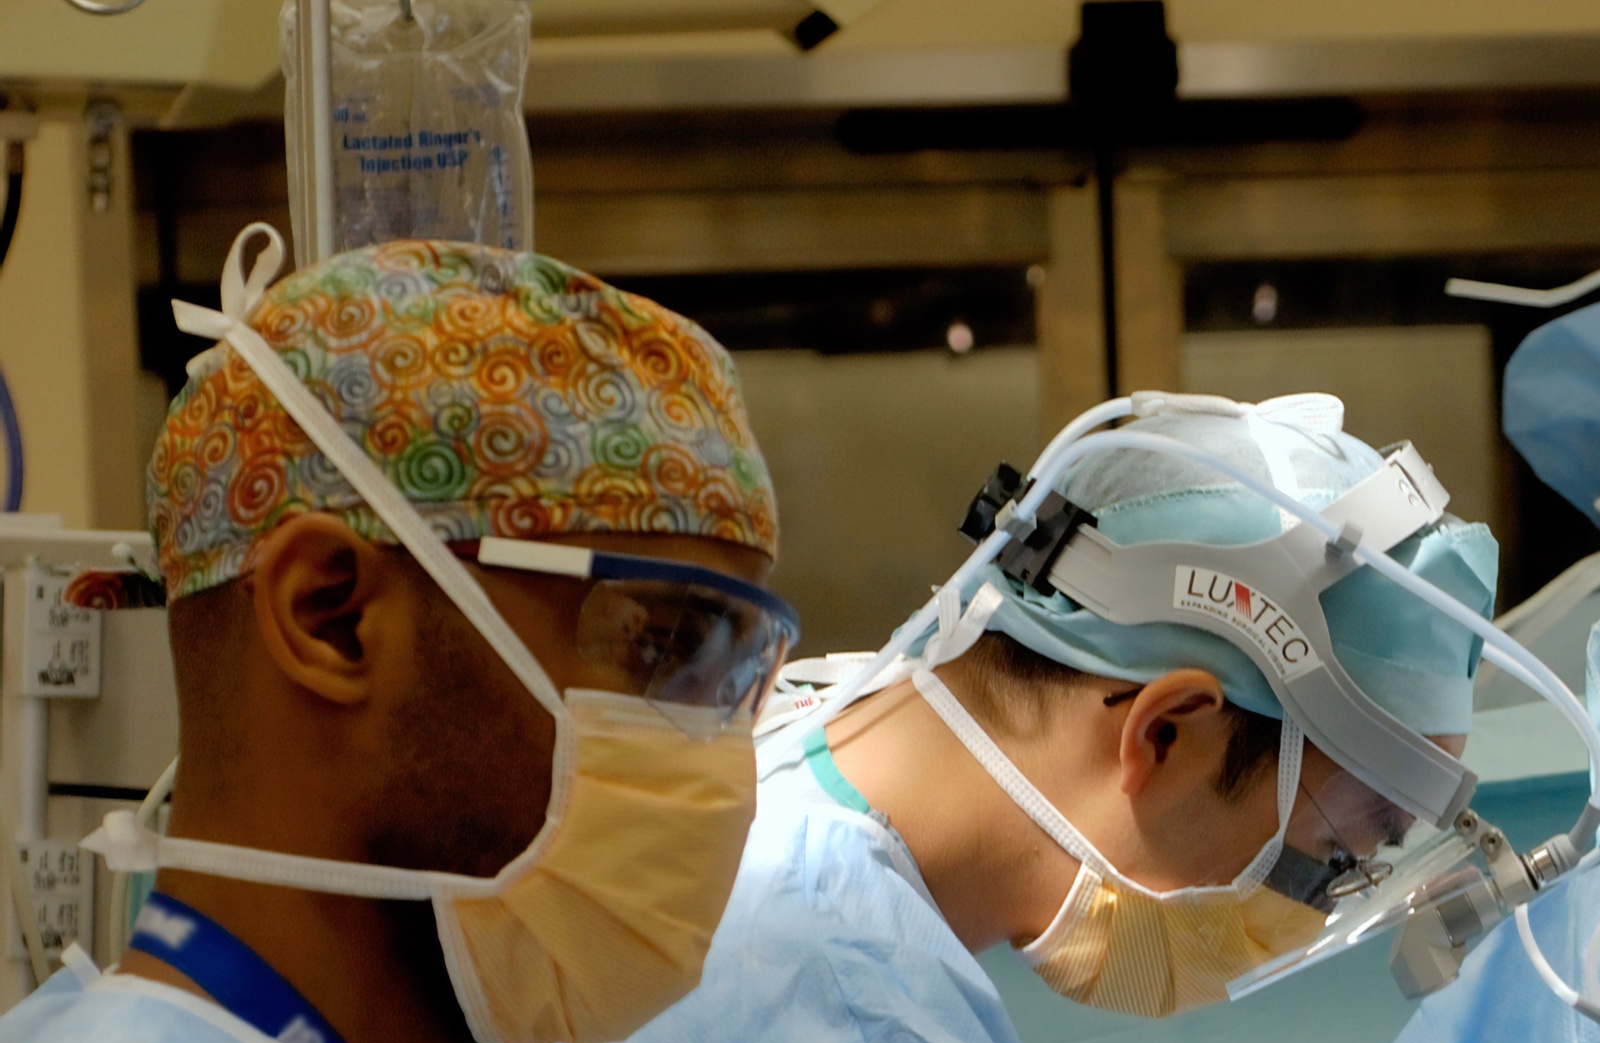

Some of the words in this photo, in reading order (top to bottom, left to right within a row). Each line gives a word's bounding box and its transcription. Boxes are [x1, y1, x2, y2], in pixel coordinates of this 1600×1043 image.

[343, 132, 412, 150] Lactated
[419, 128, 481, 147] Ringer's
[360, 155, 432, 174] Injection
[437, 150, 468, 169] USP
[1187, 569, 1309, 664] LUXTEC
